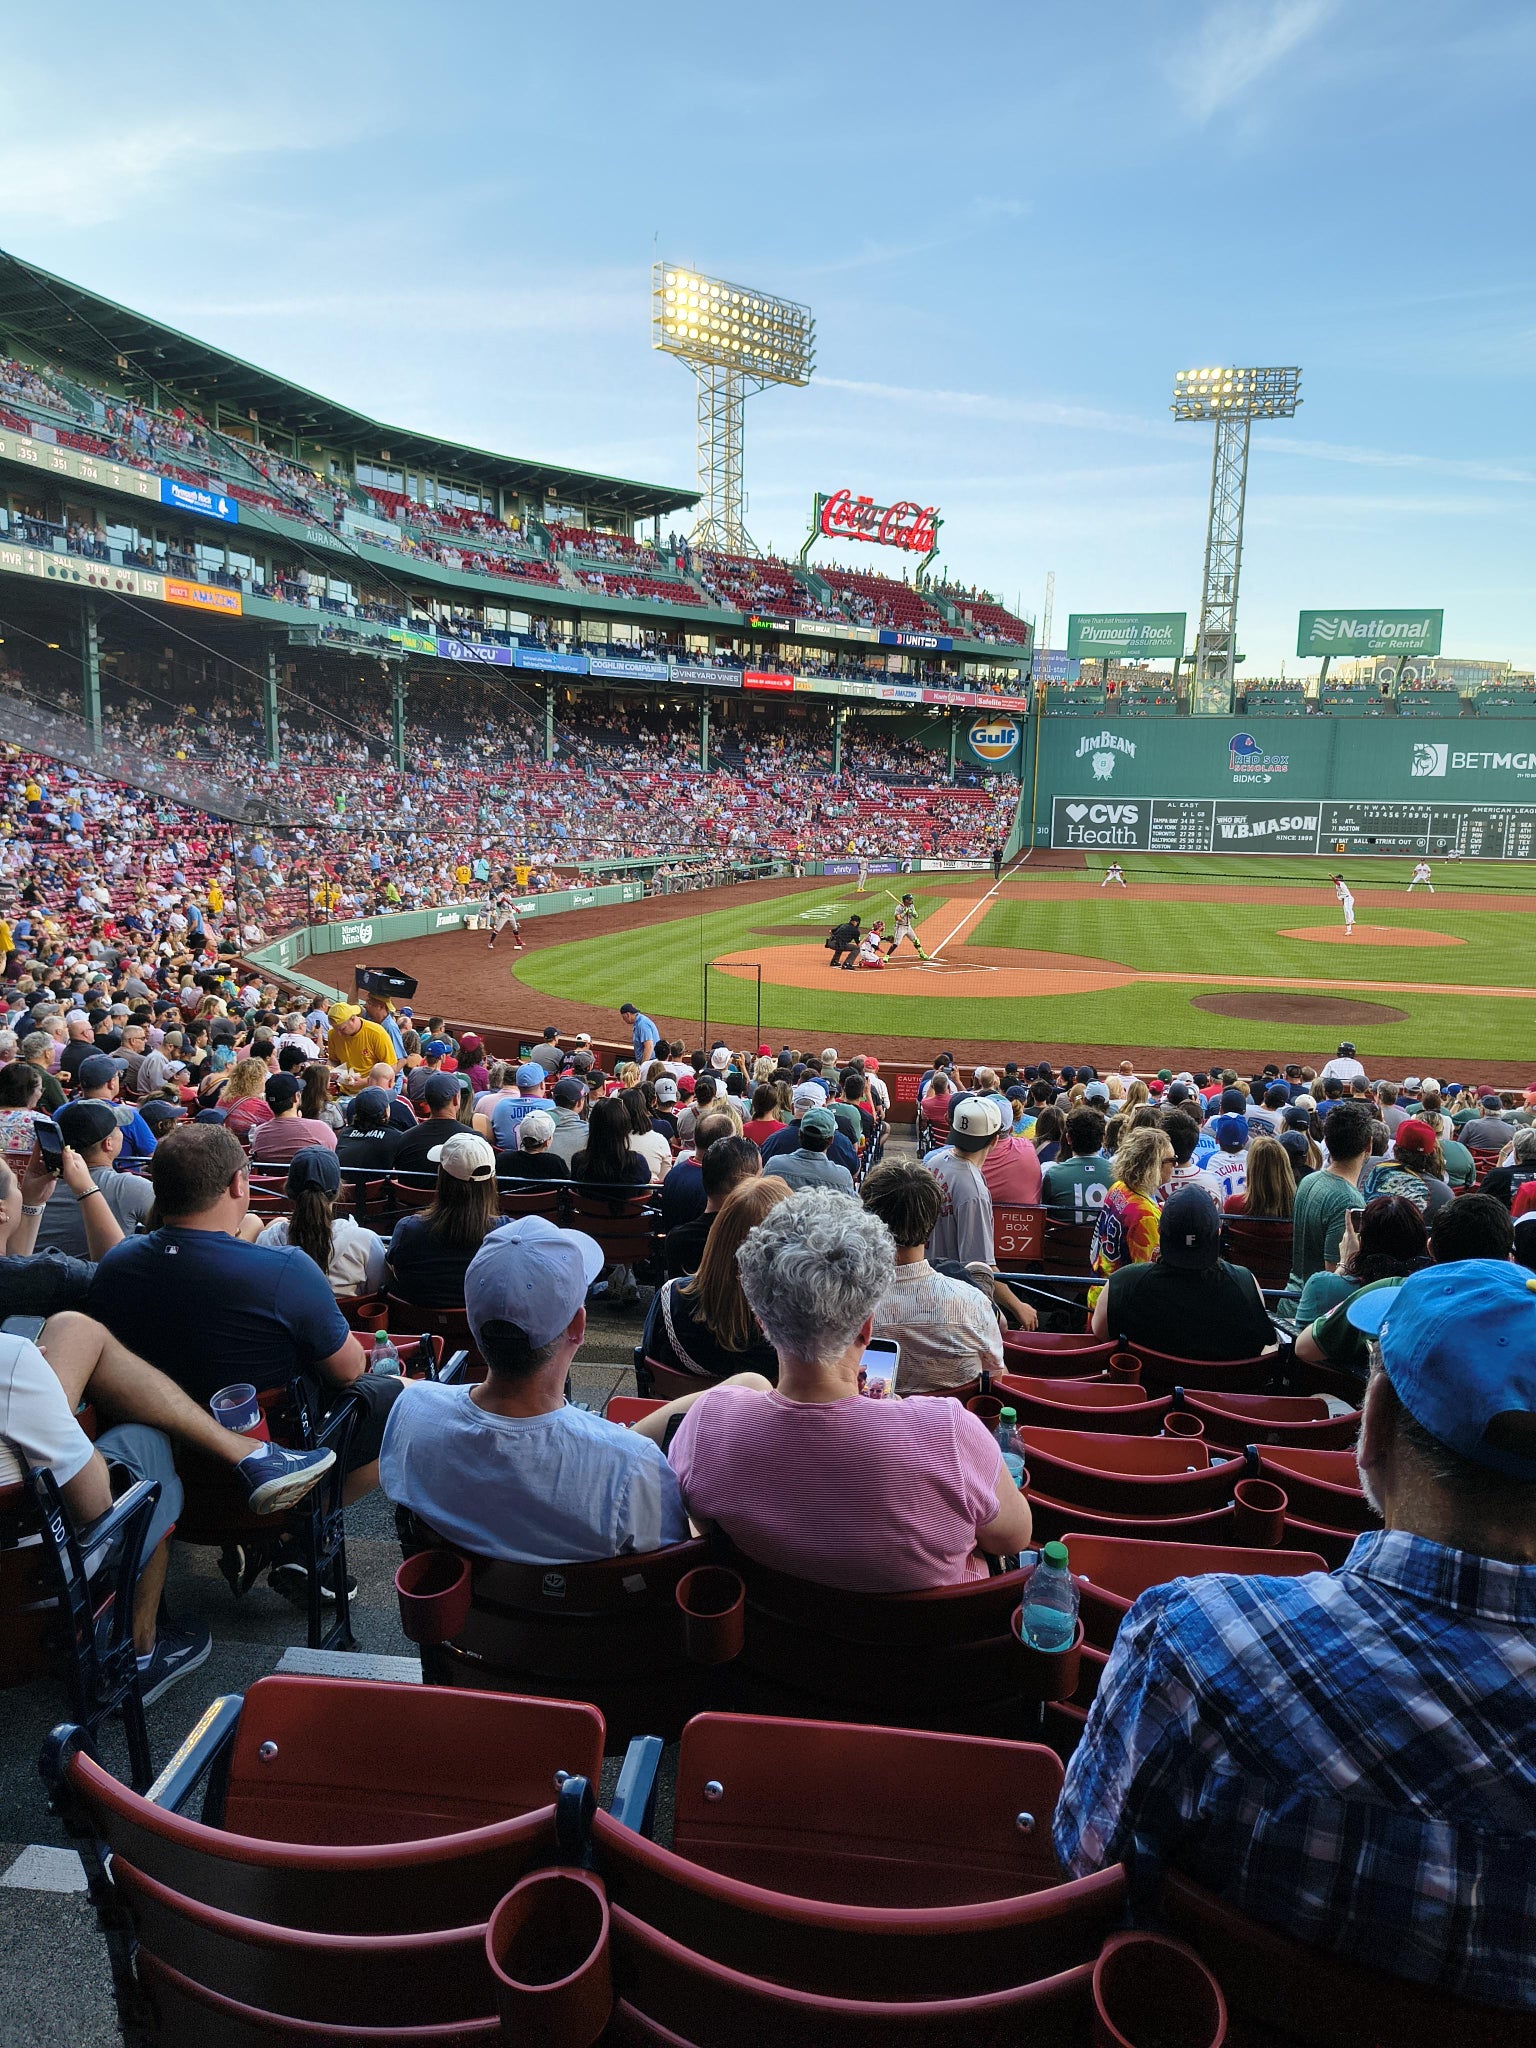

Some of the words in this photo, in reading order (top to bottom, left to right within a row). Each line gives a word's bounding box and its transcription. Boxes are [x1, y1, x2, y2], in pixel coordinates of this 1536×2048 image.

[18, 448, 37, 461] .353
[51, 458, 67, 470] .351
[80, 466, 97, 479] .704
[114, 476, 120, 485] 2
[139, 484, 147, 493] 12
[1, 551, 22, 566] MVR
[28, 553, 34, 561] 4
[28, 564, 34, 573] 4
[53, 556, 75, 569] BALL
[86, 563, 111, 576] STRIKE
[117, 569, 132, 580] OUT
[143, 579, 159, 594] 1ST
[192, 590, 239, 610] AMAZING
[1080, 625, 1139, 641] Plymouth
[1140, 625, 1173, 639] Rock
[1337, 619, 1430, 638] National
[905, 637, 938, 648] UNITED
[1130, 638, 1172, 646] assurance
[1368, 640, 1386, 648] Car
[1389, 640, 1424, 648] Rental
[463, 646, 496, 660] HYCU
[591, 660, 625, 670] COGHLIN
[625, 661, 667, 673] COMPANIES
[679, 670, 716, 680] VINEYARD
[716, 672, 739, 682] VINES
[978, 697, 1002, 707] Safelite
[971, 729, 1015, 744] Gulf
[1235, 755, 1258, 764] RED
[1264, 755, 1289, 765] SOX
[1234, 765, 1289, 773] SCHOLARS
[1233, 774, 1261, 783] BIDMC
[1089, 804, 1139, 824] CVS
[1037, 827, 1049, 835] 310
[1067, 825, 1137, 844] Health
[1336, 844, 1345, 853] 13
[833, 865, 852, 874] xfinity
[341, 925, 361, 935] Ninety
[341, 935, 361, 945] Nine
[960, 1116, 969, 1130] B
[1002, 1213, 1034, 1222] FIELD
[1006, 1223, 1029, 1231] BOX
[999, 1235, 1033, 1252] 37
